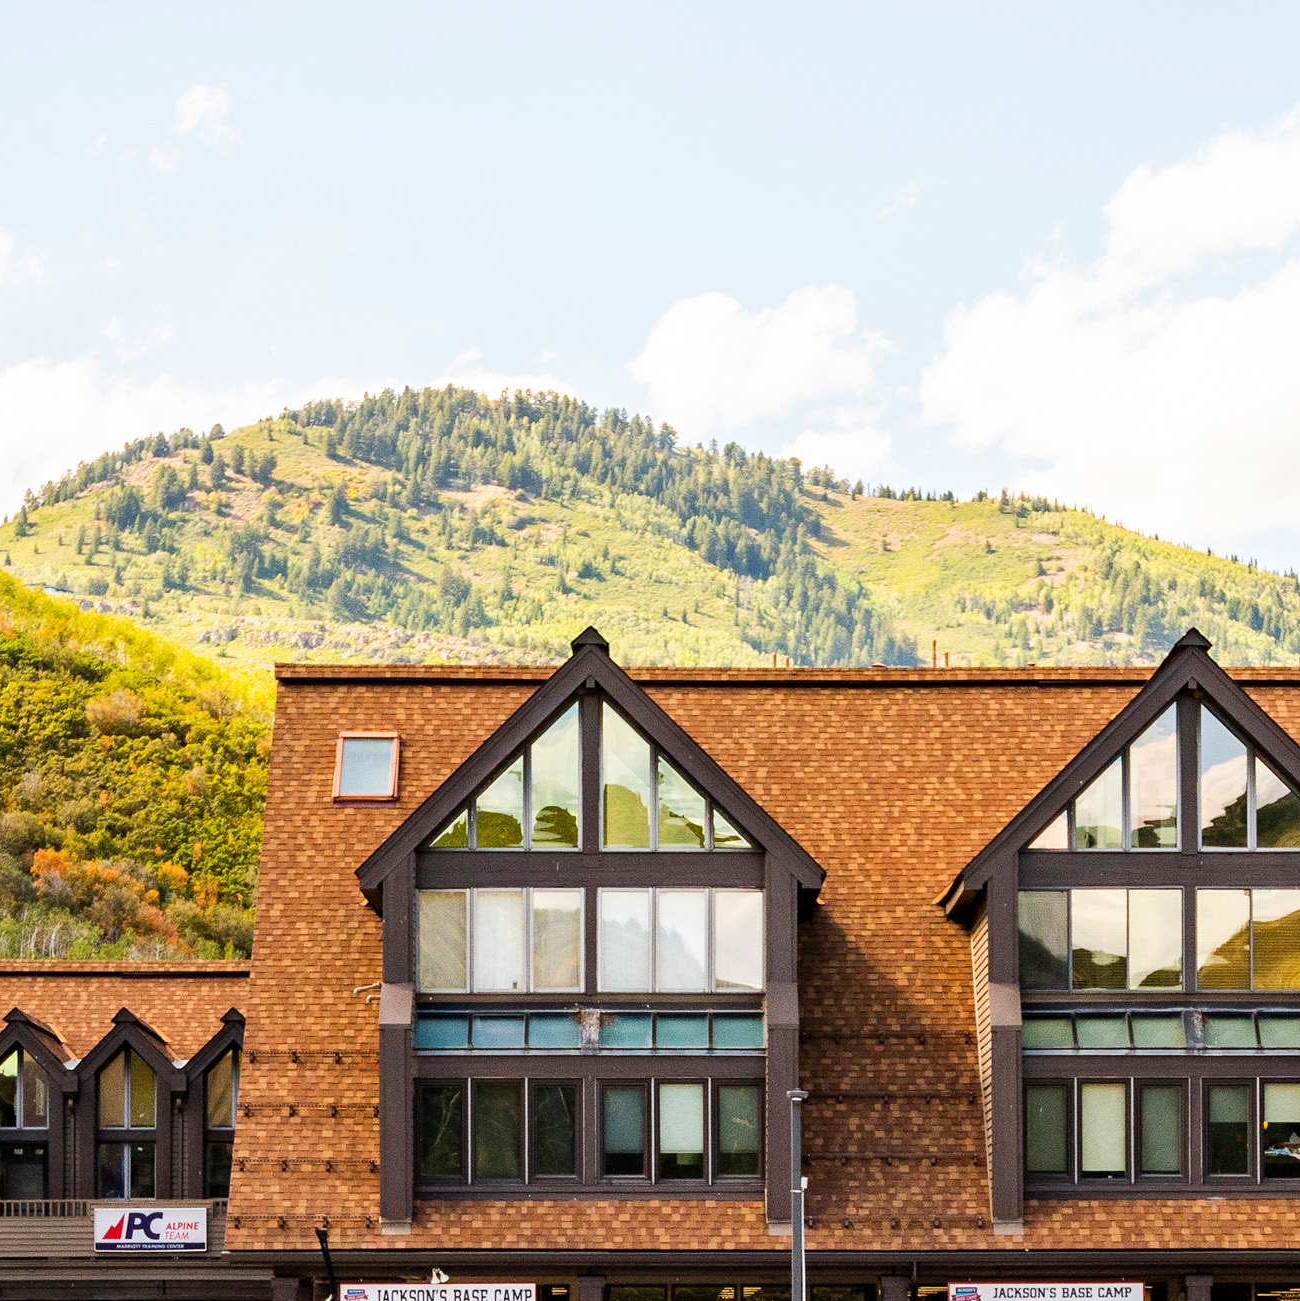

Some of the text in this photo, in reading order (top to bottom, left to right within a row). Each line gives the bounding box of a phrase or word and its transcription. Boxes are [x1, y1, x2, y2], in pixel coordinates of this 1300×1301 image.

[125, 1212, 164, 1240] PC
[165, 1222, 199, 1231] ALPINE
[165, 1232, 189, 1240] TEAM
[993, 1287, 1132, 1299] JACKSON'S BASE CAMP
